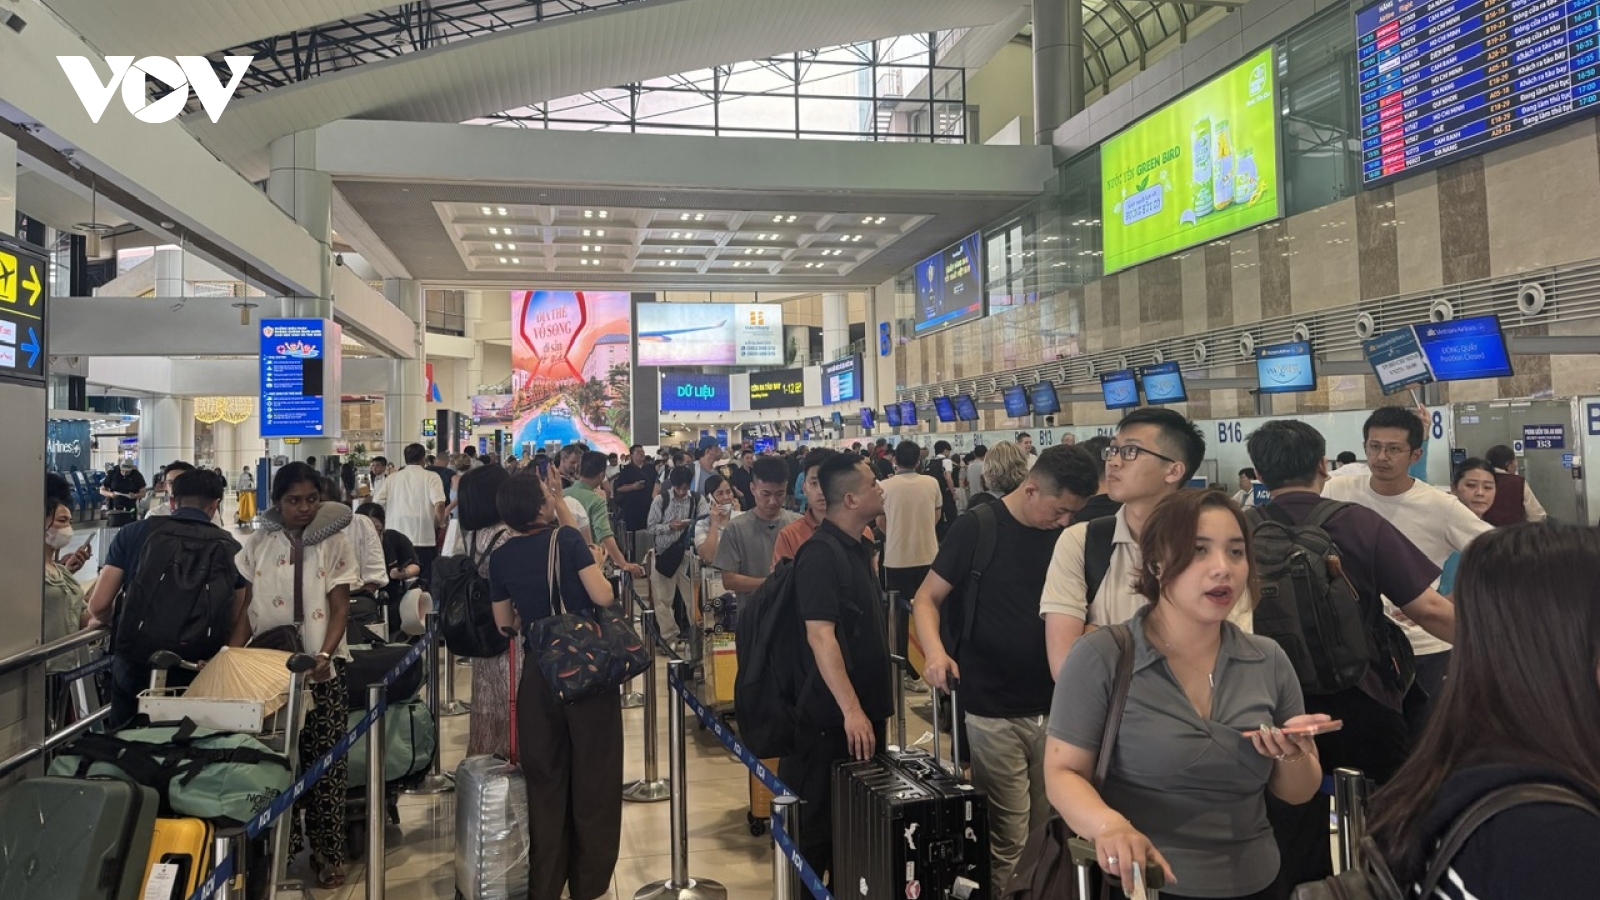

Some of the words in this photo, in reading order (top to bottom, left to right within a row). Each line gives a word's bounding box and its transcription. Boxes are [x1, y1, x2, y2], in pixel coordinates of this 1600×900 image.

[1136, 155, 1161, 176] GREEN
[1162, 145, 1181, 165] BIRD
[547, 320, 572, 338] SONG
[1440, 353, 1463, 363] Position
[1463, 351, 1485, 362] Closed
[677, 383, 693, 397] DỮ
[694, 384, 715, 400] LIỆU
[1040, 430, 1054, 447] B13
[1217, 421, 1242, 448] B16
